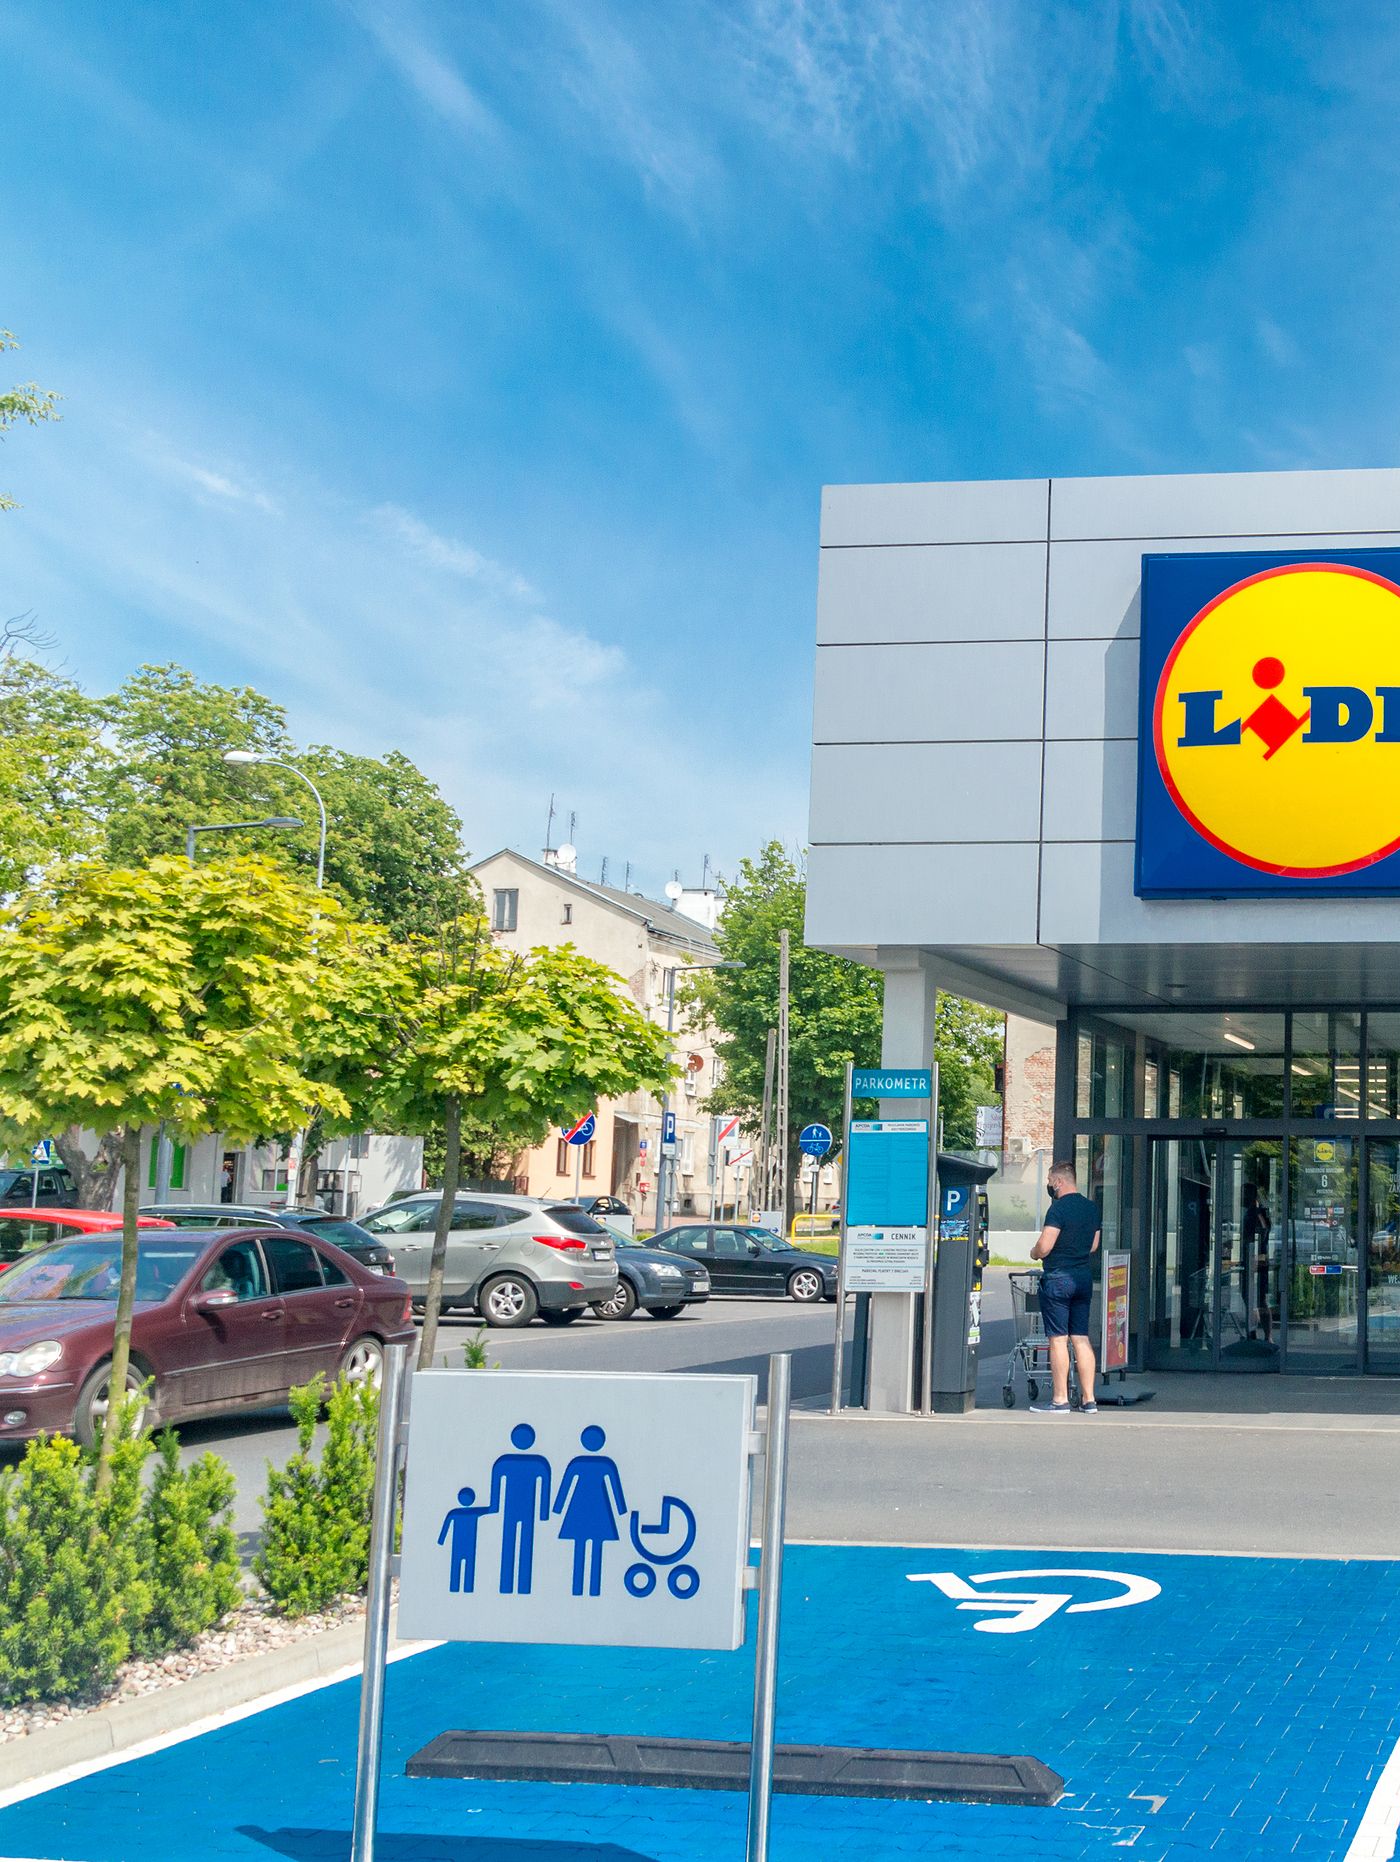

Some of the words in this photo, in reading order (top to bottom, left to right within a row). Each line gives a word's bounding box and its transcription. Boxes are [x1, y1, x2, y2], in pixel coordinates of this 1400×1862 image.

[855, 1077, 928, 1090] PARKOMETR
[665, 1115, 674, 1140] P
[1321, 1174, 1328, 1188] 6
[946, 1190, 961, 1211] P
